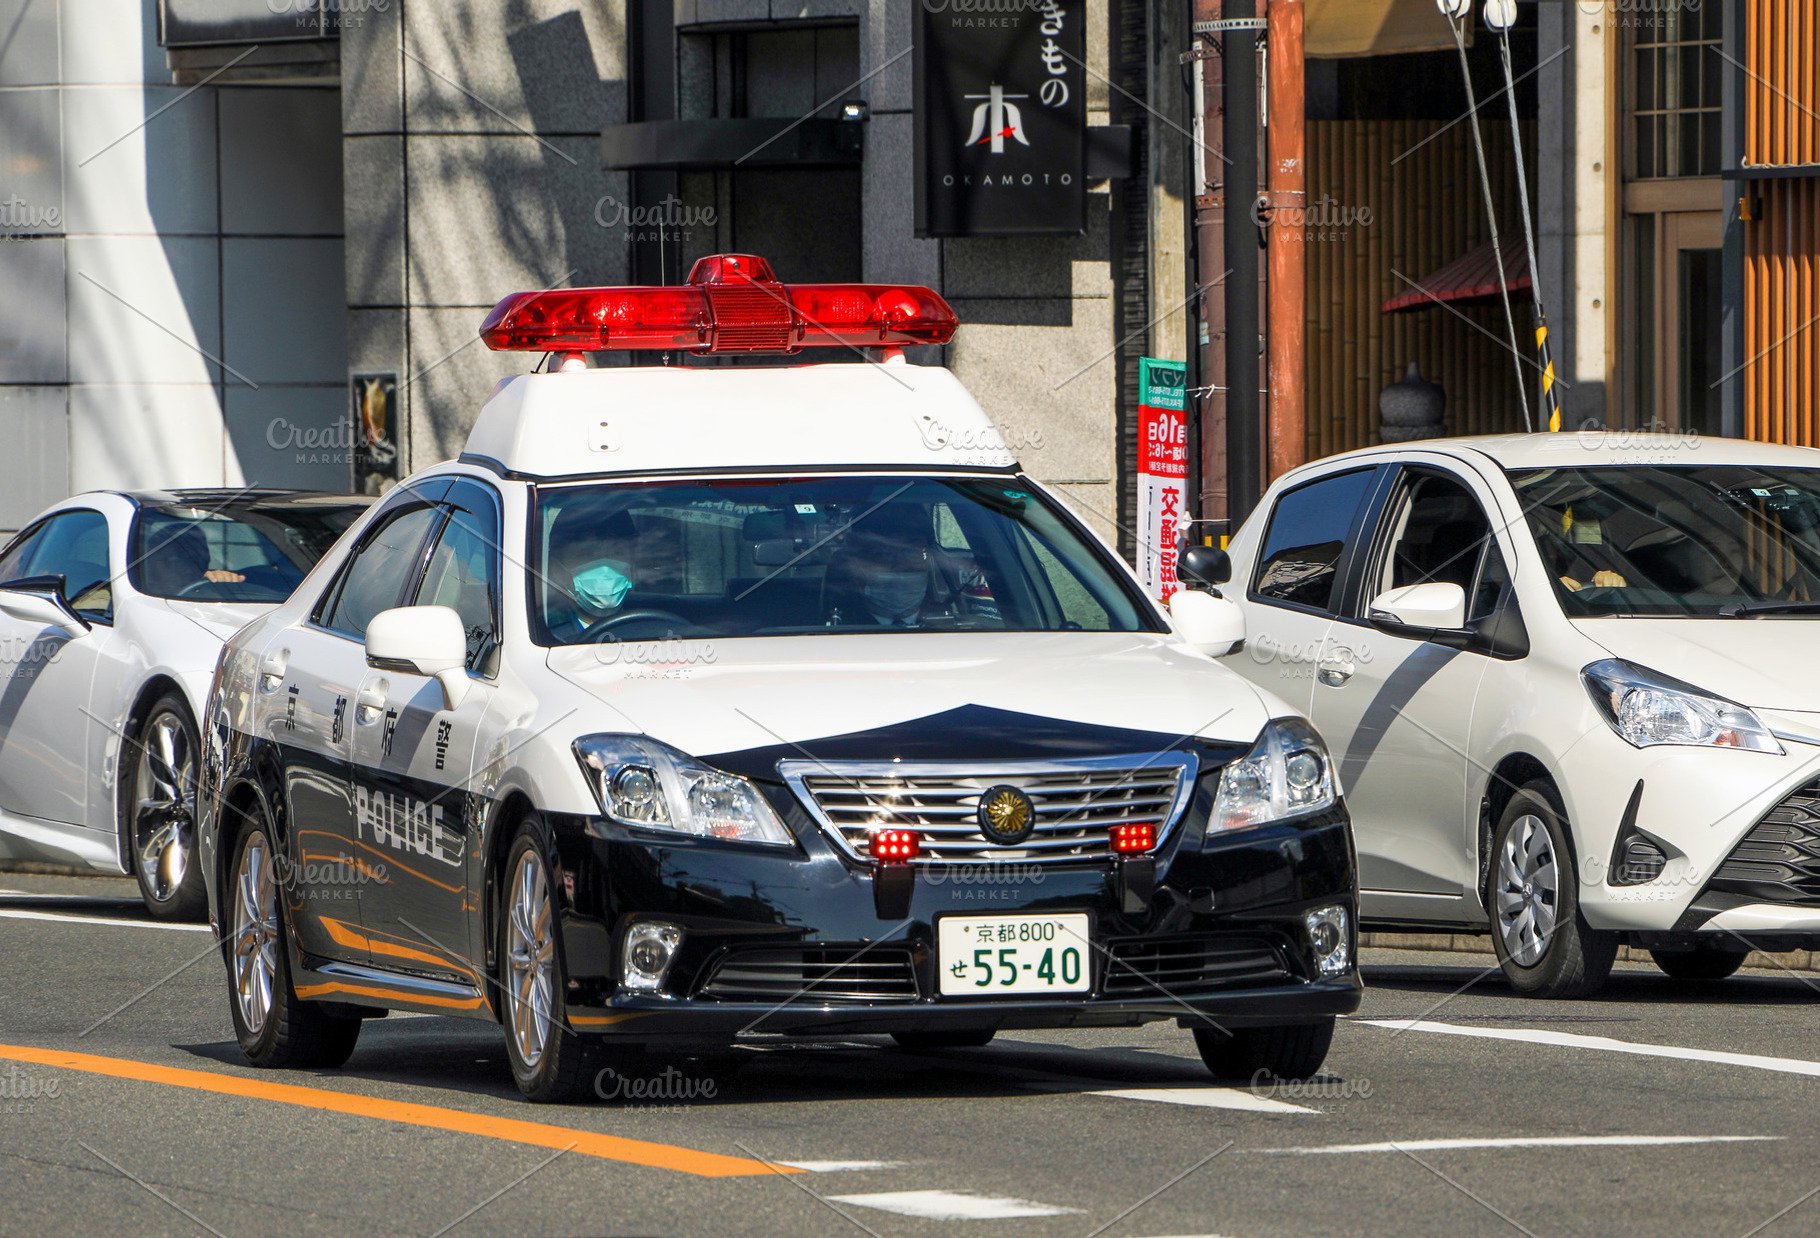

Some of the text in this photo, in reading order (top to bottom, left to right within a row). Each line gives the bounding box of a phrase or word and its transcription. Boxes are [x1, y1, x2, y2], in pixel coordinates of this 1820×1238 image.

[1039, 0, 1070, 108] きもの
[943, 173, 1072, 187] OKAMOTO
[285, 684, 452, 770] 京都府警
[356, 785, 443, 860] POLICE
[976, 922, 1054, 942] 京都800
[950, 947, 1080, 987] せ 55-40
